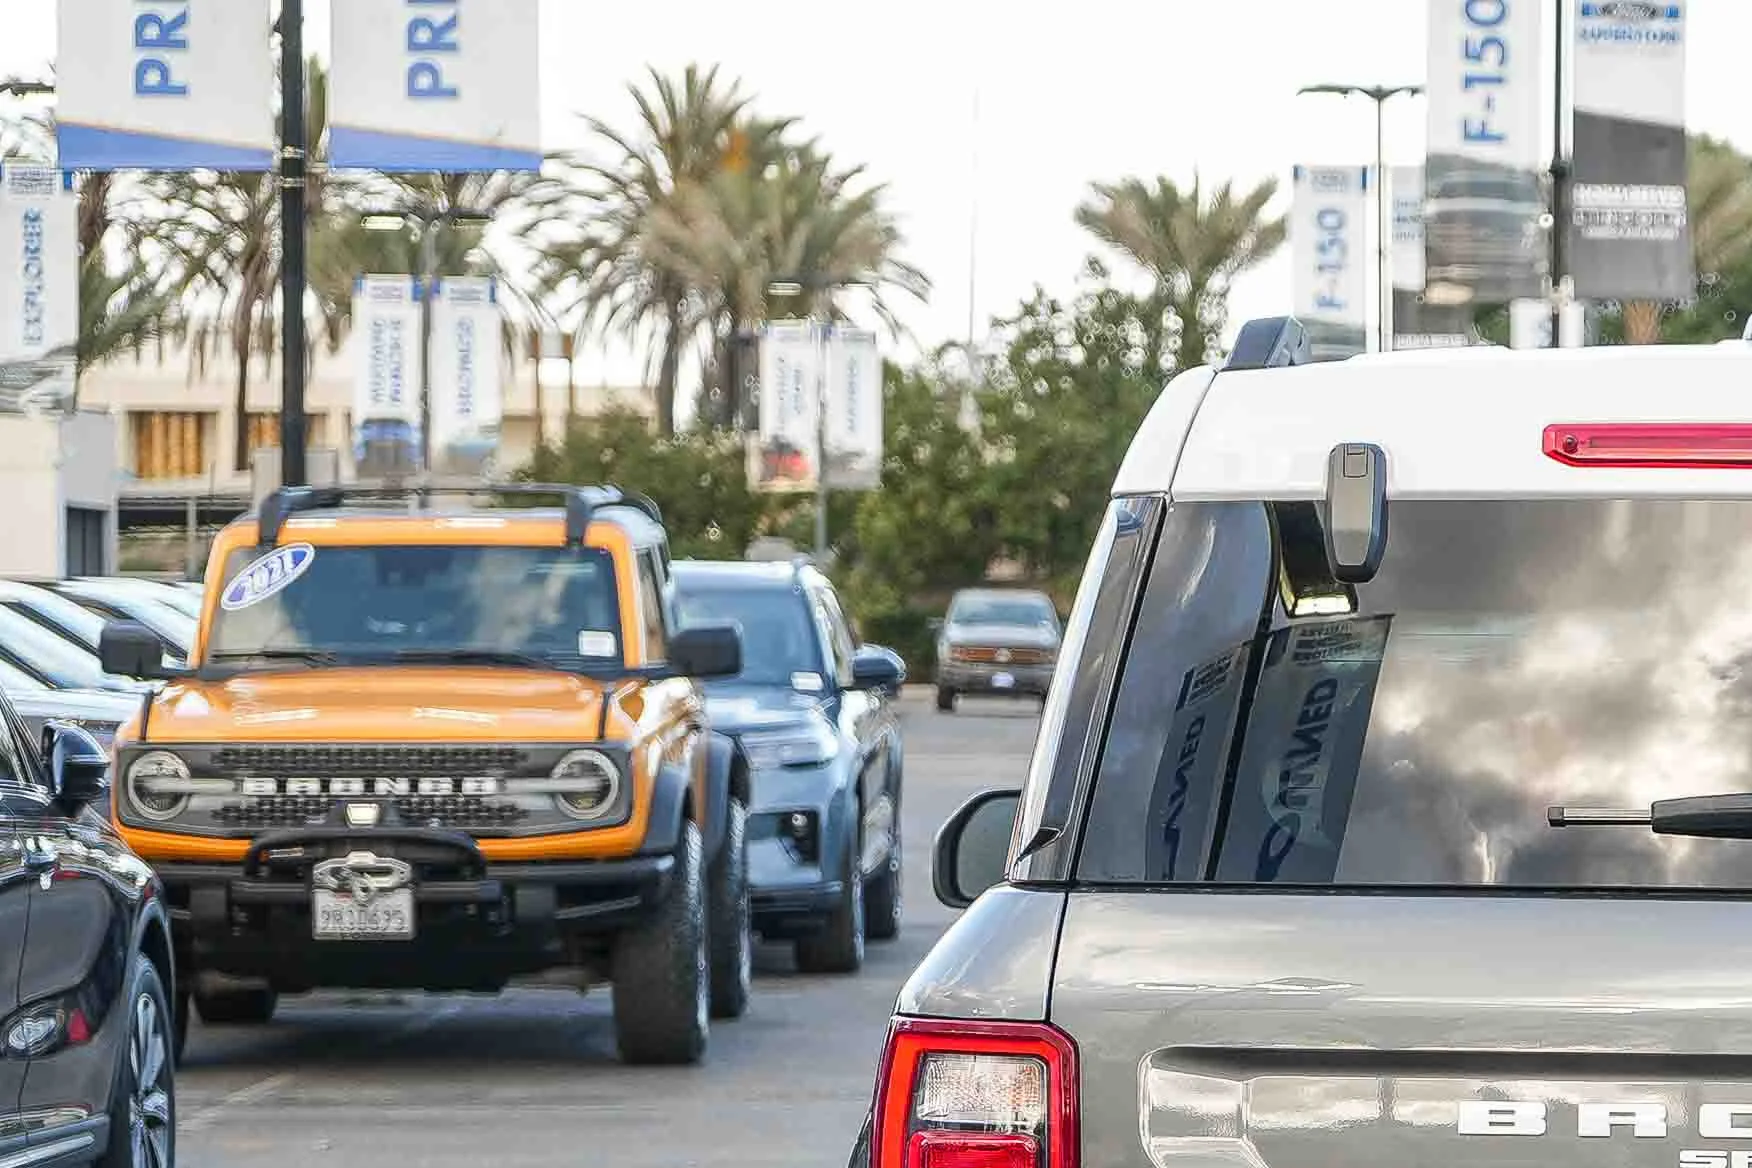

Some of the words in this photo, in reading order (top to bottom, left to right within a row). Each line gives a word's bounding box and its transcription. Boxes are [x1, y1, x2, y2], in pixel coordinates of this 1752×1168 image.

[135, 0, 187, 95] PR
[407, 0, 457, 97] PR
[1463, 0, 1508, 143] F-150
[242, 776, 501, 796] BRONCO
